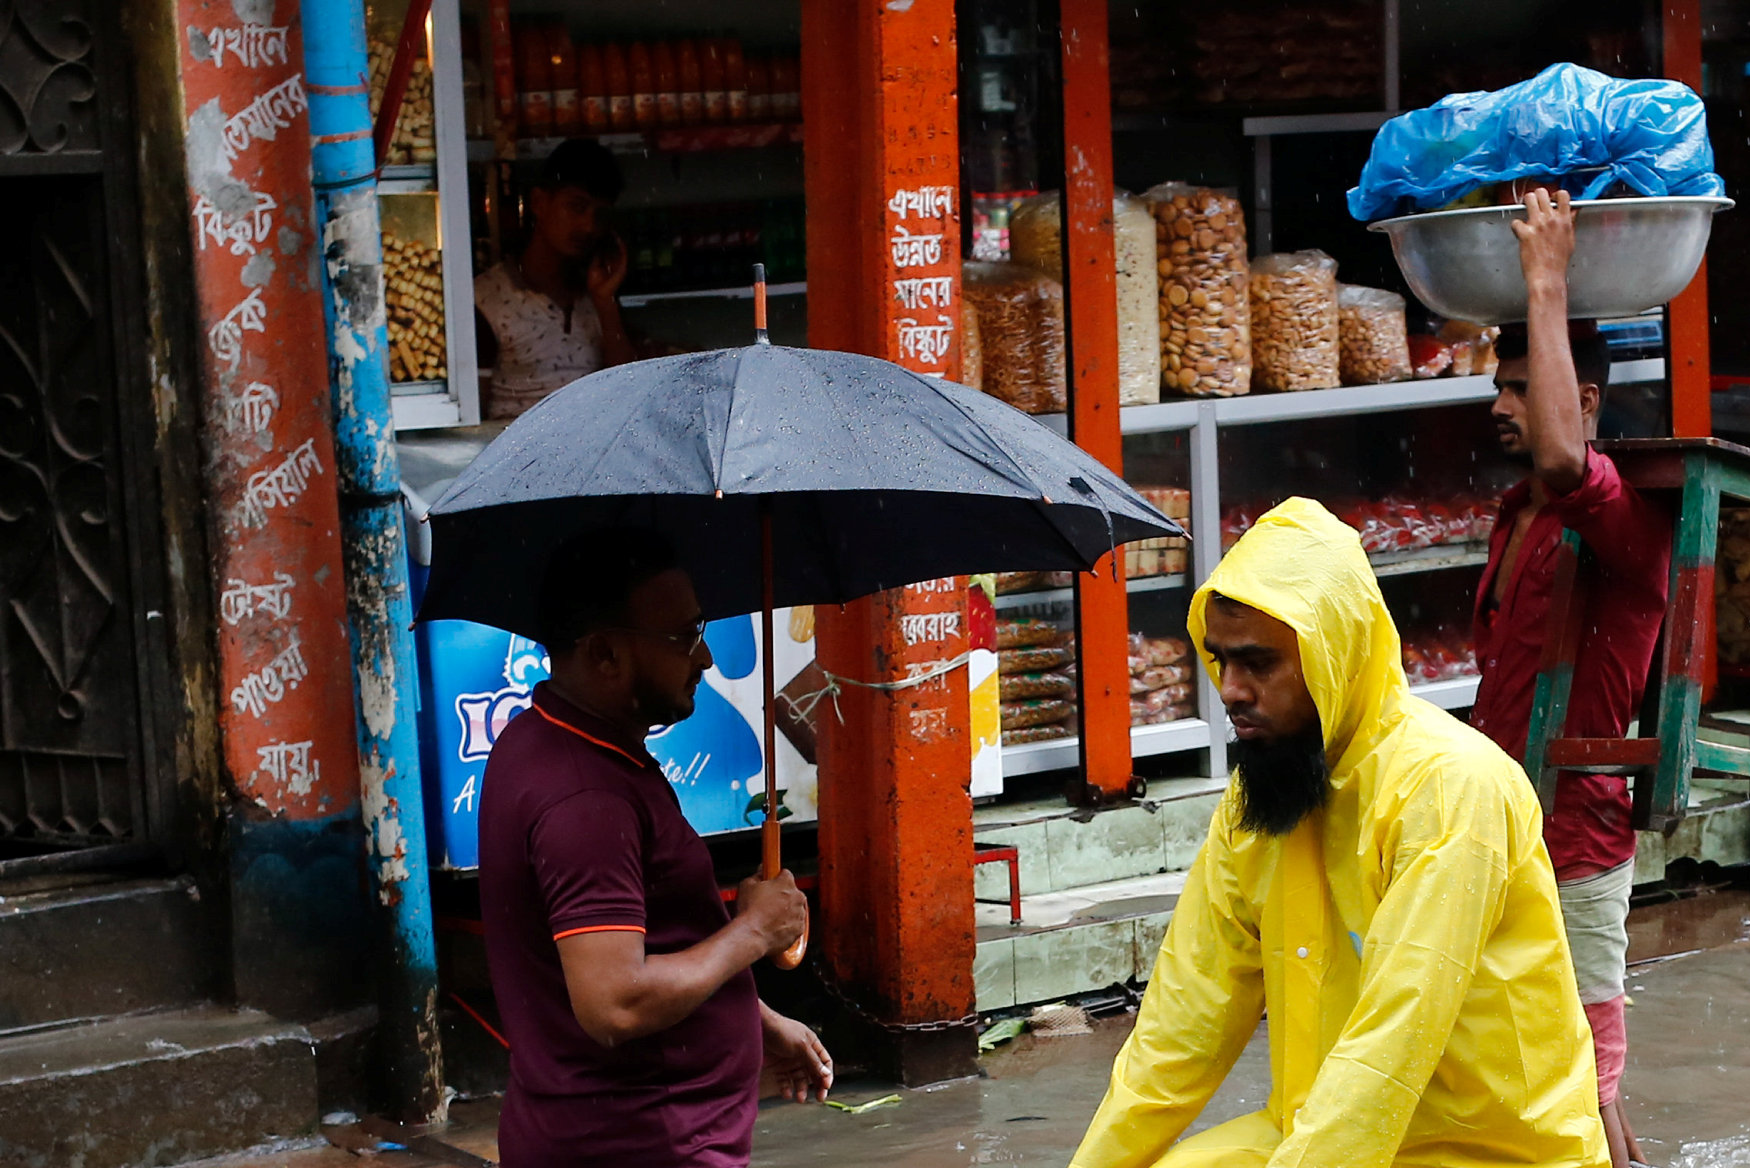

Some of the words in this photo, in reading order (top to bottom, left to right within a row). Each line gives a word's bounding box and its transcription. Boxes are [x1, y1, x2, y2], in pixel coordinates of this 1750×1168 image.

[888, 184, 954, 220] এখানে
[891, 224, 944, 268] উন্নত
[893, 276, 953, 310] মানের
[897, 314, 954, 365] বিস্কুট
